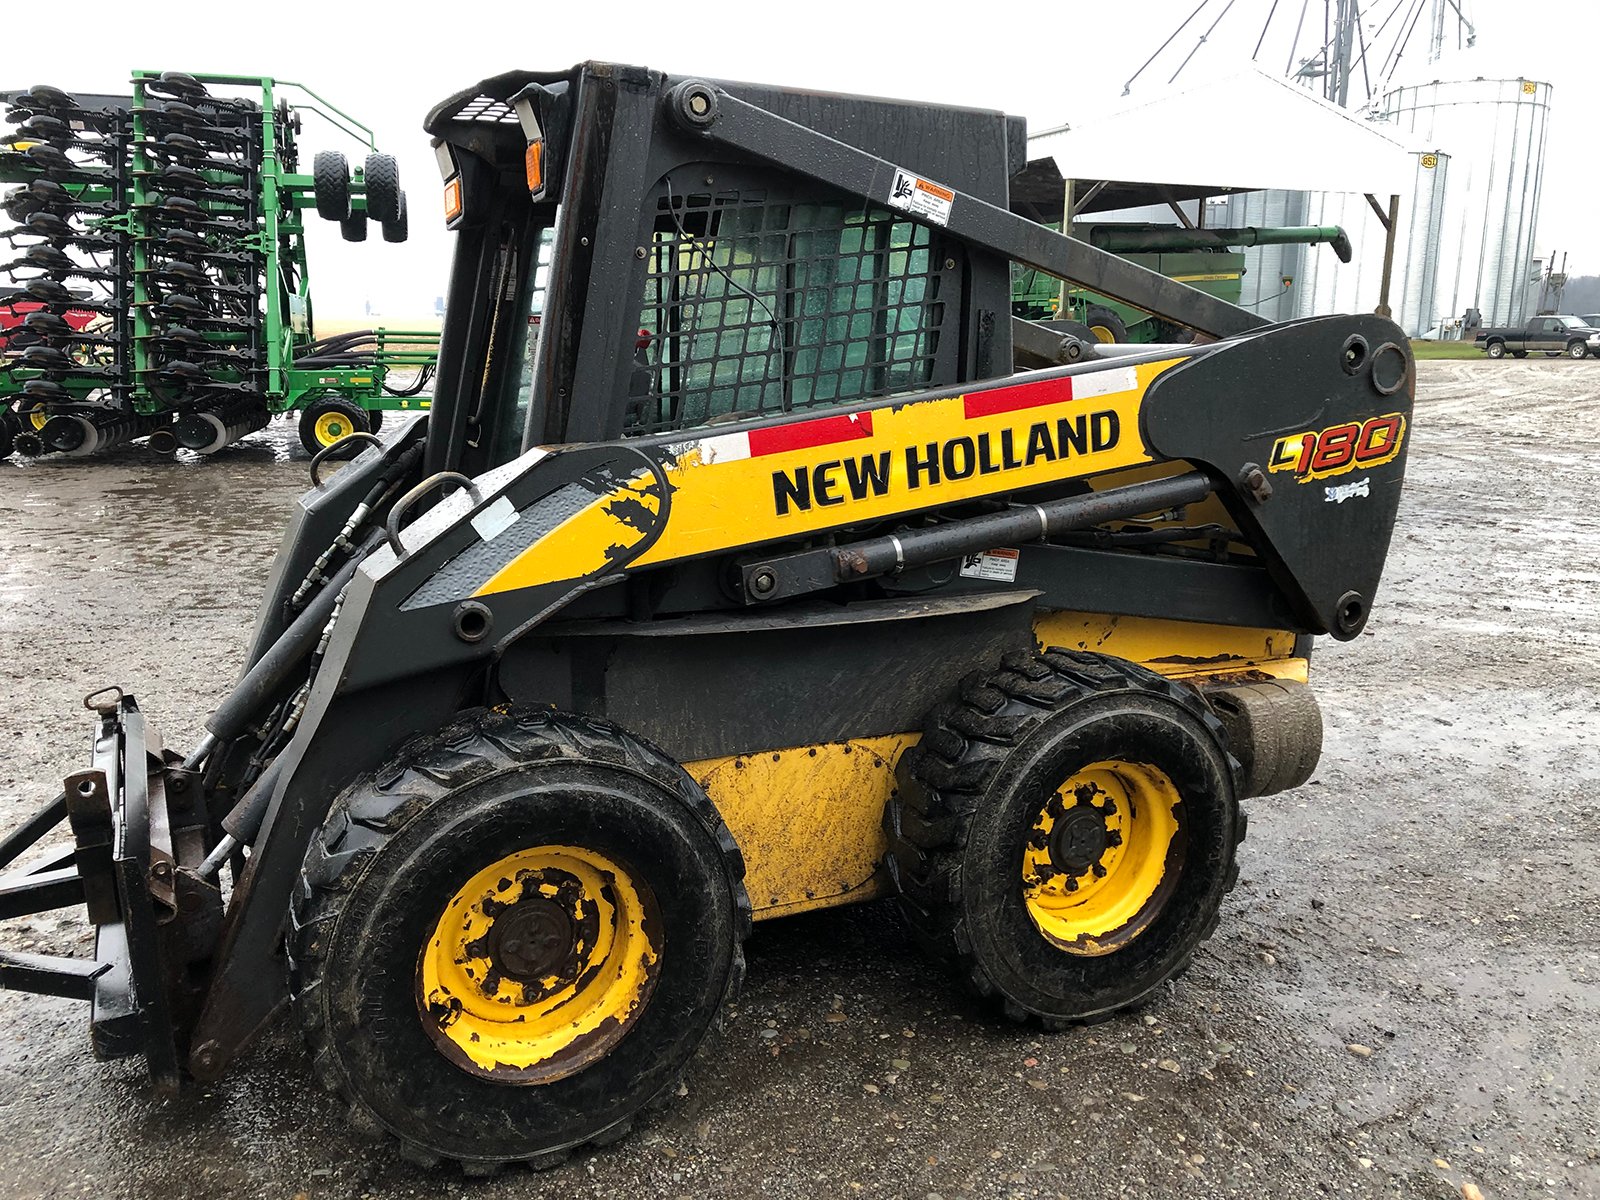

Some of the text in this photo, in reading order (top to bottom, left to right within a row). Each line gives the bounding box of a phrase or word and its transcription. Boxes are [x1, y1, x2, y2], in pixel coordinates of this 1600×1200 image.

[1422, 157, 1436, 166] GSI
[925, 185, 950, 199] WARNING
[772, 409, 1121, 516] NEW HOLLAND
[1269, 417, 1402, 480] L180
